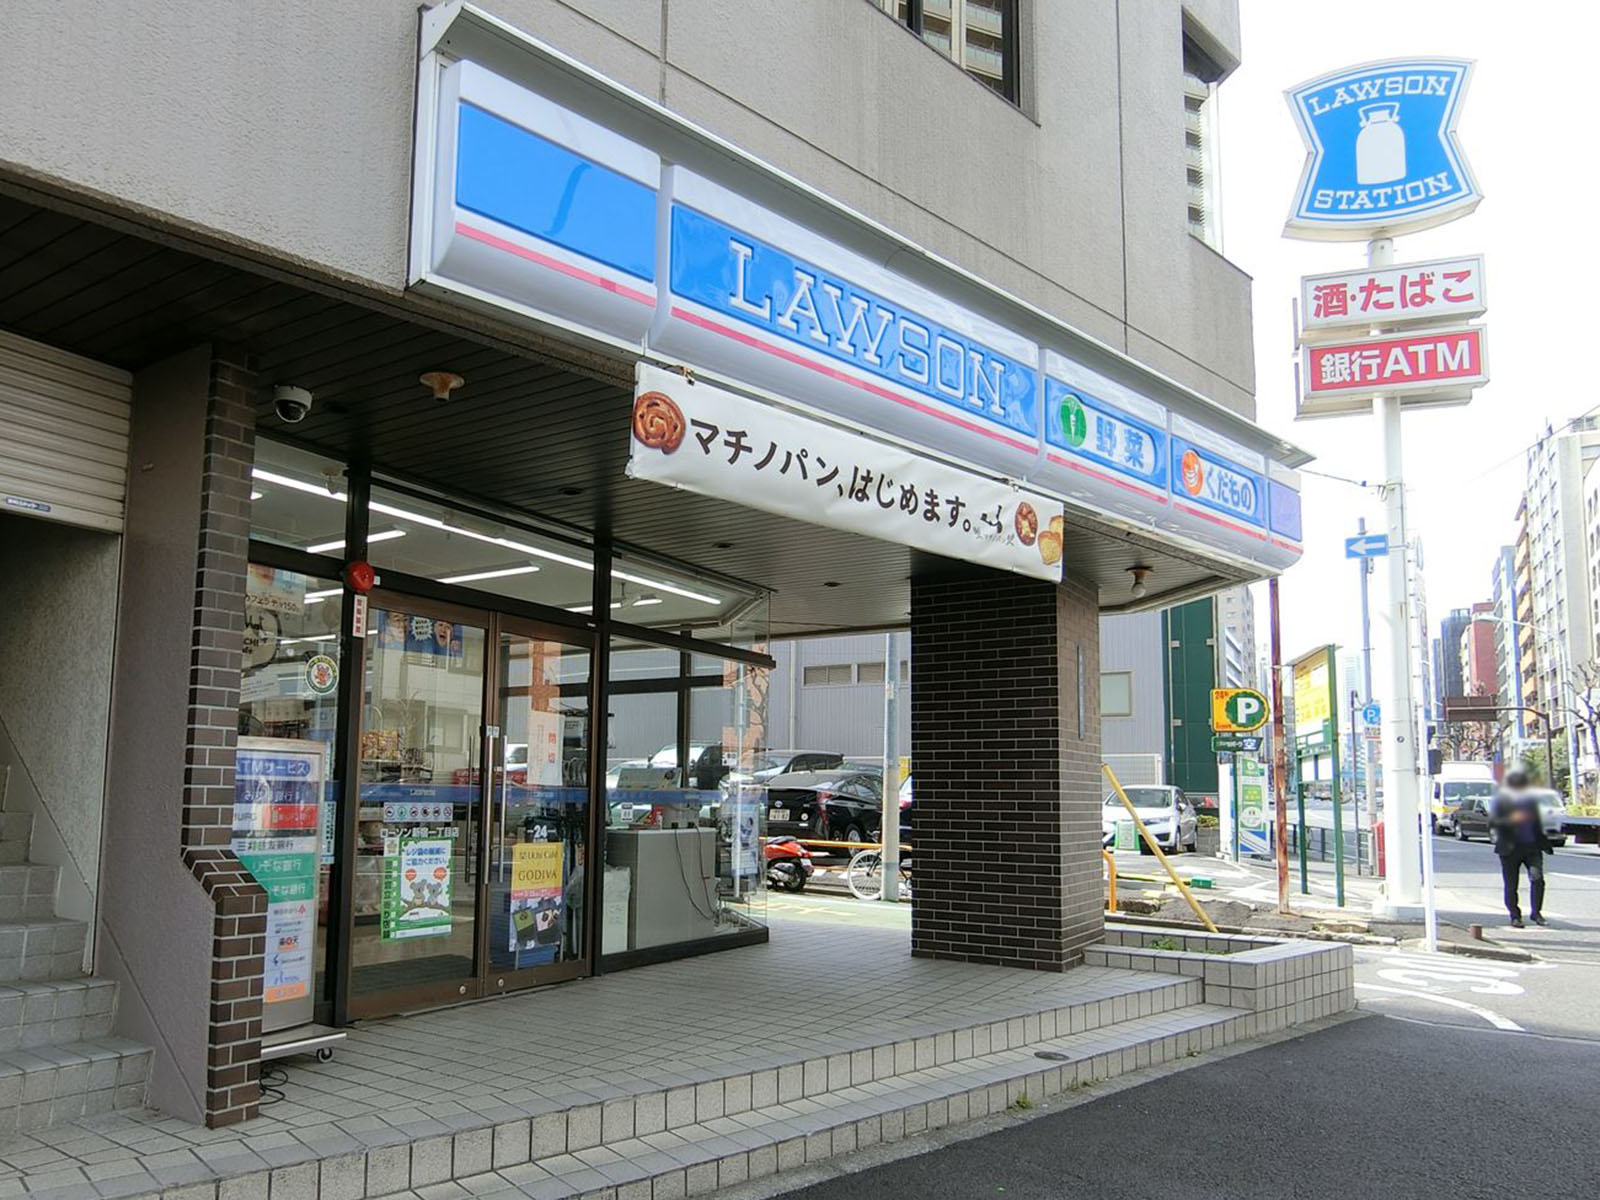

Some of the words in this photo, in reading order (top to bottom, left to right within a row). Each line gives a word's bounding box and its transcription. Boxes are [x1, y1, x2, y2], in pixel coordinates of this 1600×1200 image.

[1308, 75, 1450, 116] LAWSON
[1313, 171, 1453, 210] STATION
[1312, 270, 1475, 319] 酒・たばこ
[729, 237, 1006, 417] LAWSON
[1320, 339, 1471, 384] 銀行ATM
[1095, 415, 1145, 469] 野菜
[689, 417, 972, 533] マチノパン、はじめます。
[1205, 467, 1252, 511] くだもの
[1236, 697, 1260, 724] P
[518, 869, 558, 881] GODIVA
